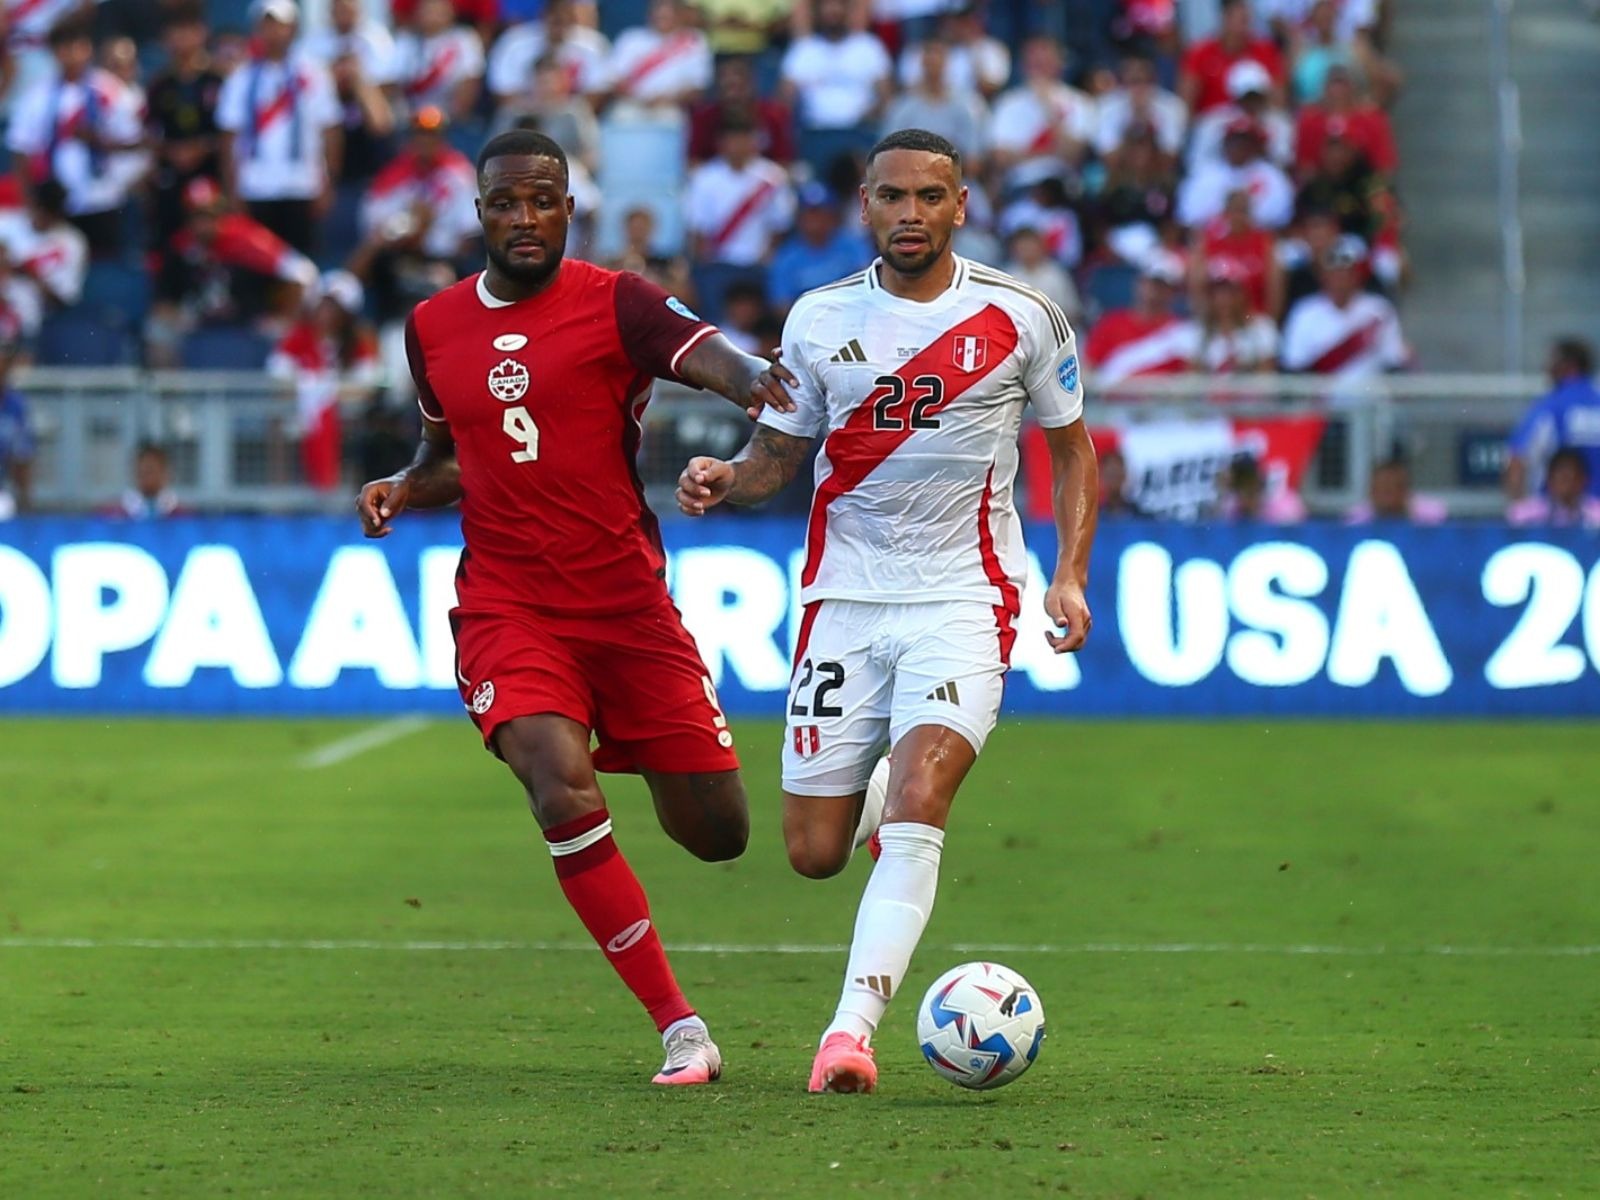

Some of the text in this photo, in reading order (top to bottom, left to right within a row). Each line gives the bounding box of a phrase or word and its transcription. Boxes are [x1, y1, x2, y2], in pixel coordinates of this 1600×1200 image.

[490, 376, 526, 386] CANADA
[873, 374, 945, 431] 22
[503, 406, 539, 463] 9
[1117, 539, 1453, 696] USA
[1480, 541, 1600, 690] 2
[790, 658, 845, 718] 22
